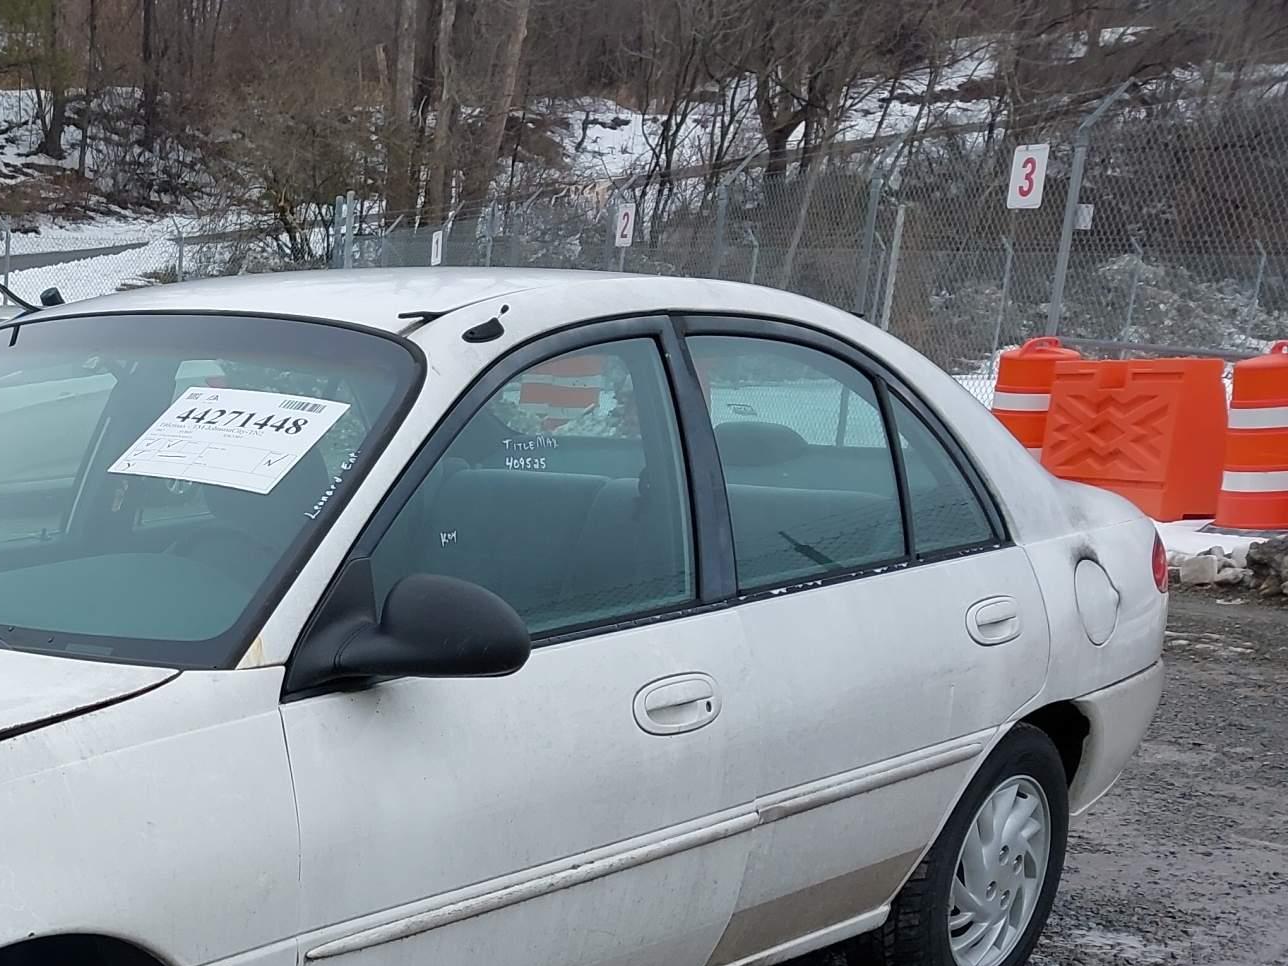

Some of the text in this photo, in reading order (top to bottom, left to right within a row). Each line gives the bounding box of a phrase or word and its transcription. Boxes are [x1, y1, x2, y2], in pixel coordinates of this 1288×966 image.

[1018, 156, 1037, 198] 3
[620, 211, 630, 239] 2
[175, 407, 310, 436] 44271448
[505, 456, 547, 471] 409525
[303, 476, 343, 519] Leonard
